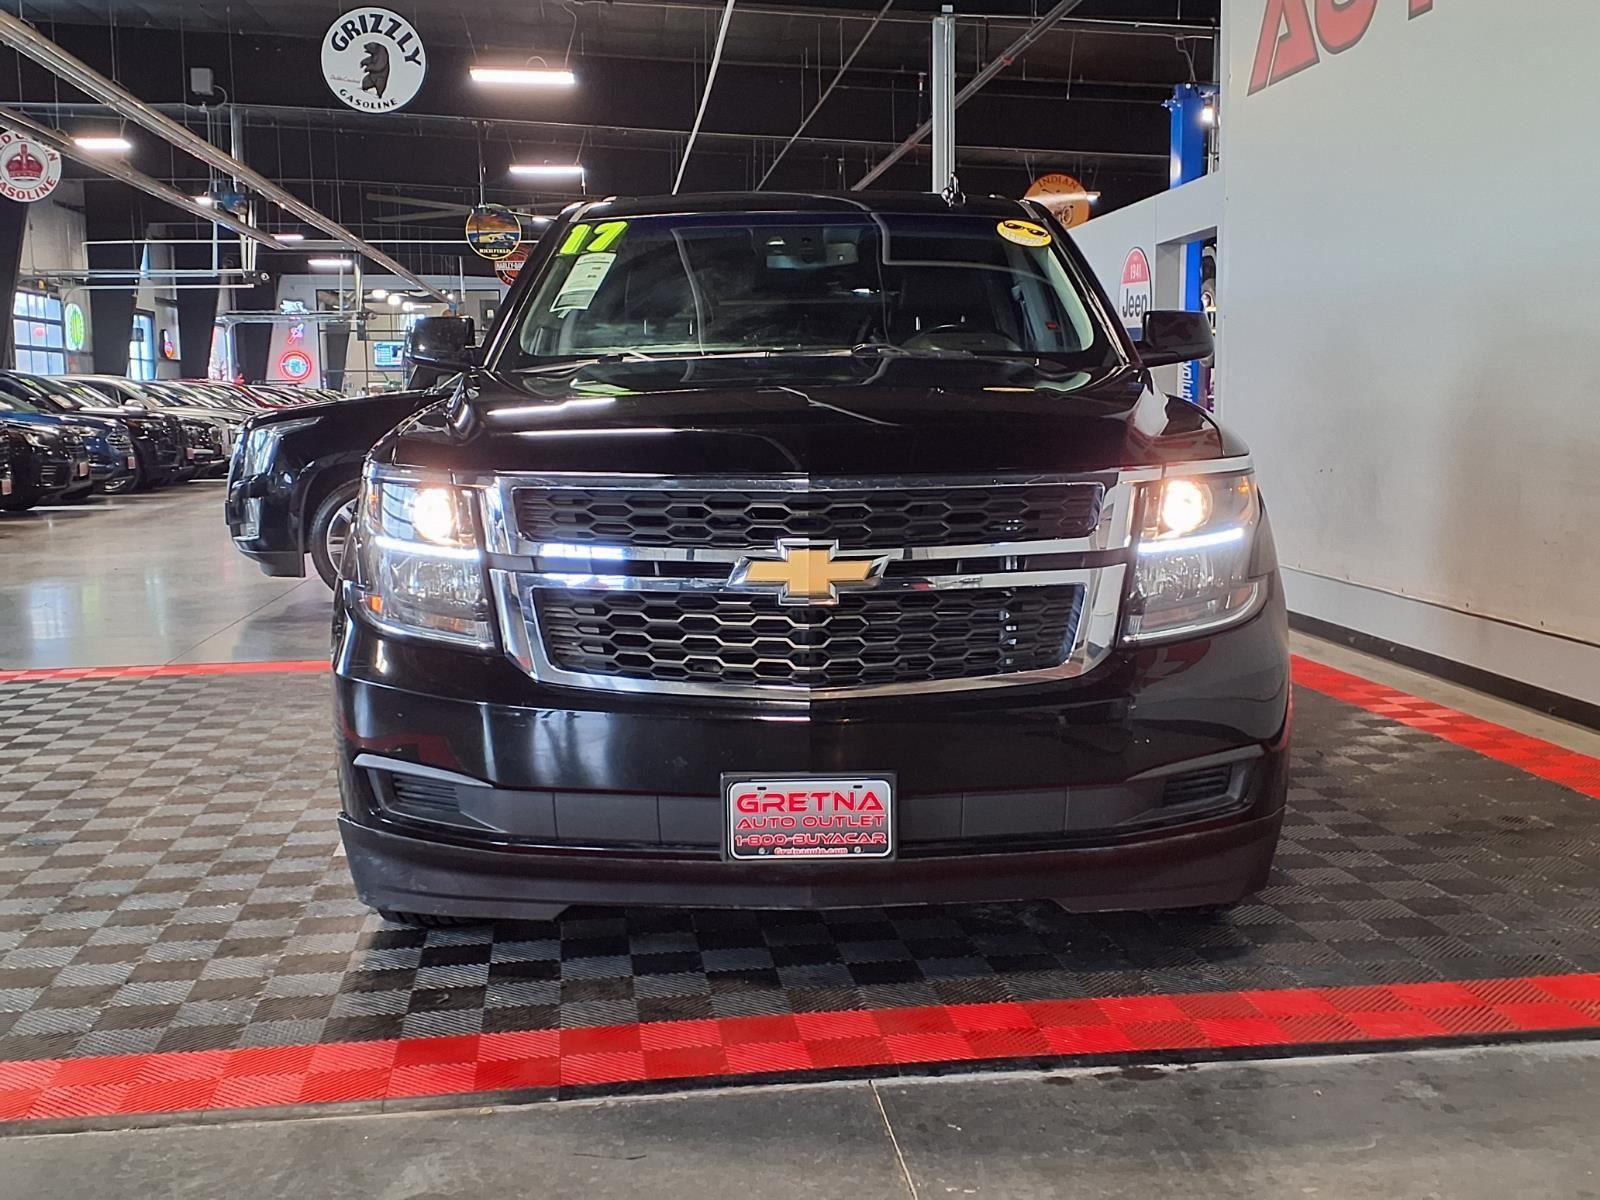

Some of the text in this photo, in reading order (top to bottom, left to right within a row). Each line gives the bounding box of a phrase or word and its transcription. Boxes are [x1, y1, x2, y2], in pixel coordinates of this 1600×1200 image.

[331, 13, 422, 66] GRIZZLY
[340, 89, 398, 110] GASOLINE
[0, 176, 57, 200] ASOLINE
[1037, 175, 1079, 189] INDIAN
[559, 221, 628, 254] 17
[1130, 263, 1142, 280] 1941
[1123, 288, 1147, 319] Jeep
[736, 791, 884, 814] GRETNA
[737, 815, 886, 830] AUTO OUTLET
[735, 832, 887, 847] 1-800-BUYACAR
